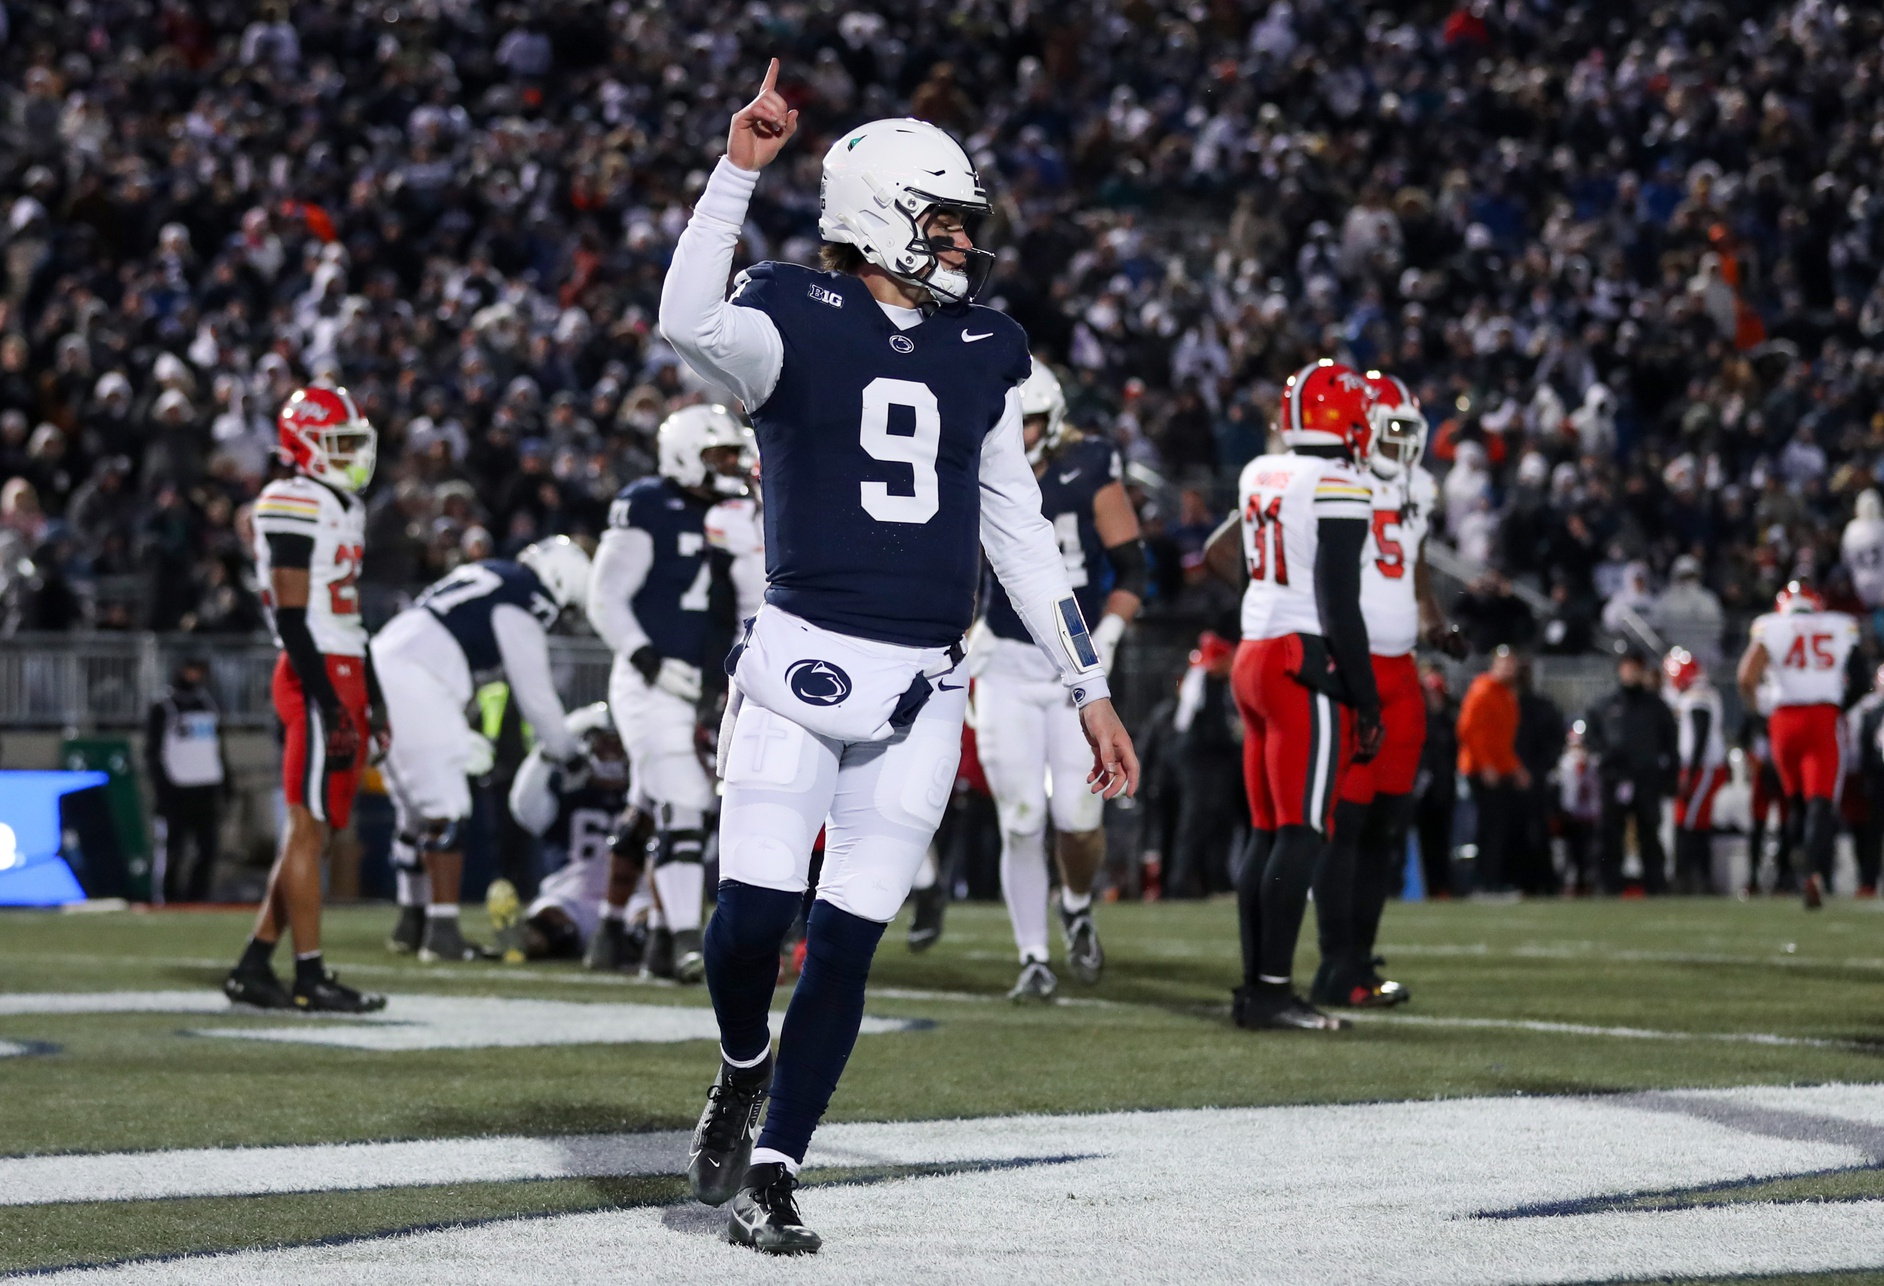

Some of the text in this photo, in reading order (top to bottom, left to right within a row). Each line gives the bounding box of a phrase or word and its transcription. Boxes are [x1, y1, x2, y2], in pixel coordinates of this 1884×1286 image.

[859, 377, 941, 525] 9
[1245, 494, 1289, 586] 31
[1371, 510, 1405, 579] 5
[1783, 633, 1836, 671] 45
